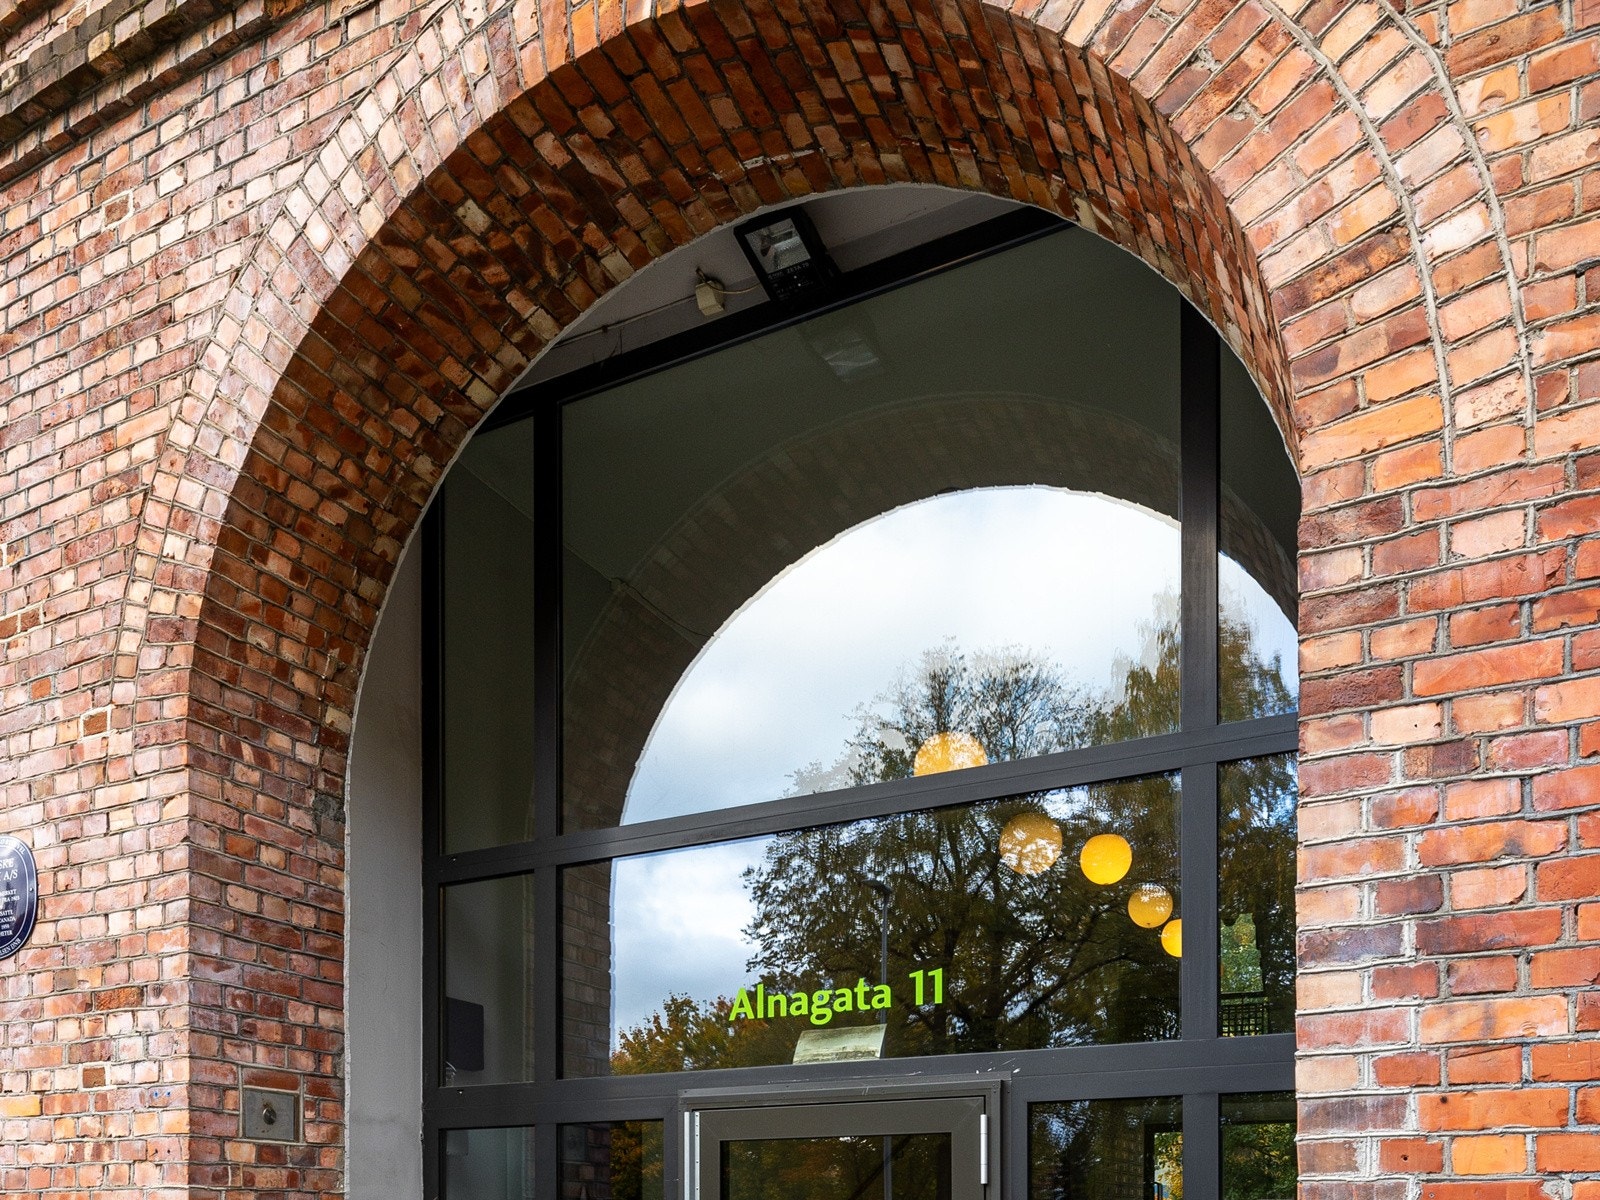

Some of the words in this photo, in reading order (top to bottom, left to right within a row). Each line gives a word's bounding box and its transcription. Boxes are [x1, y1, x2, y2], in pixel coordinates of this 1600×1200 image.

[3, 869, 18, 881] A/S
[729, 978, 892, 1026] Alnagata
[909, 968, 943, 1006] 11
